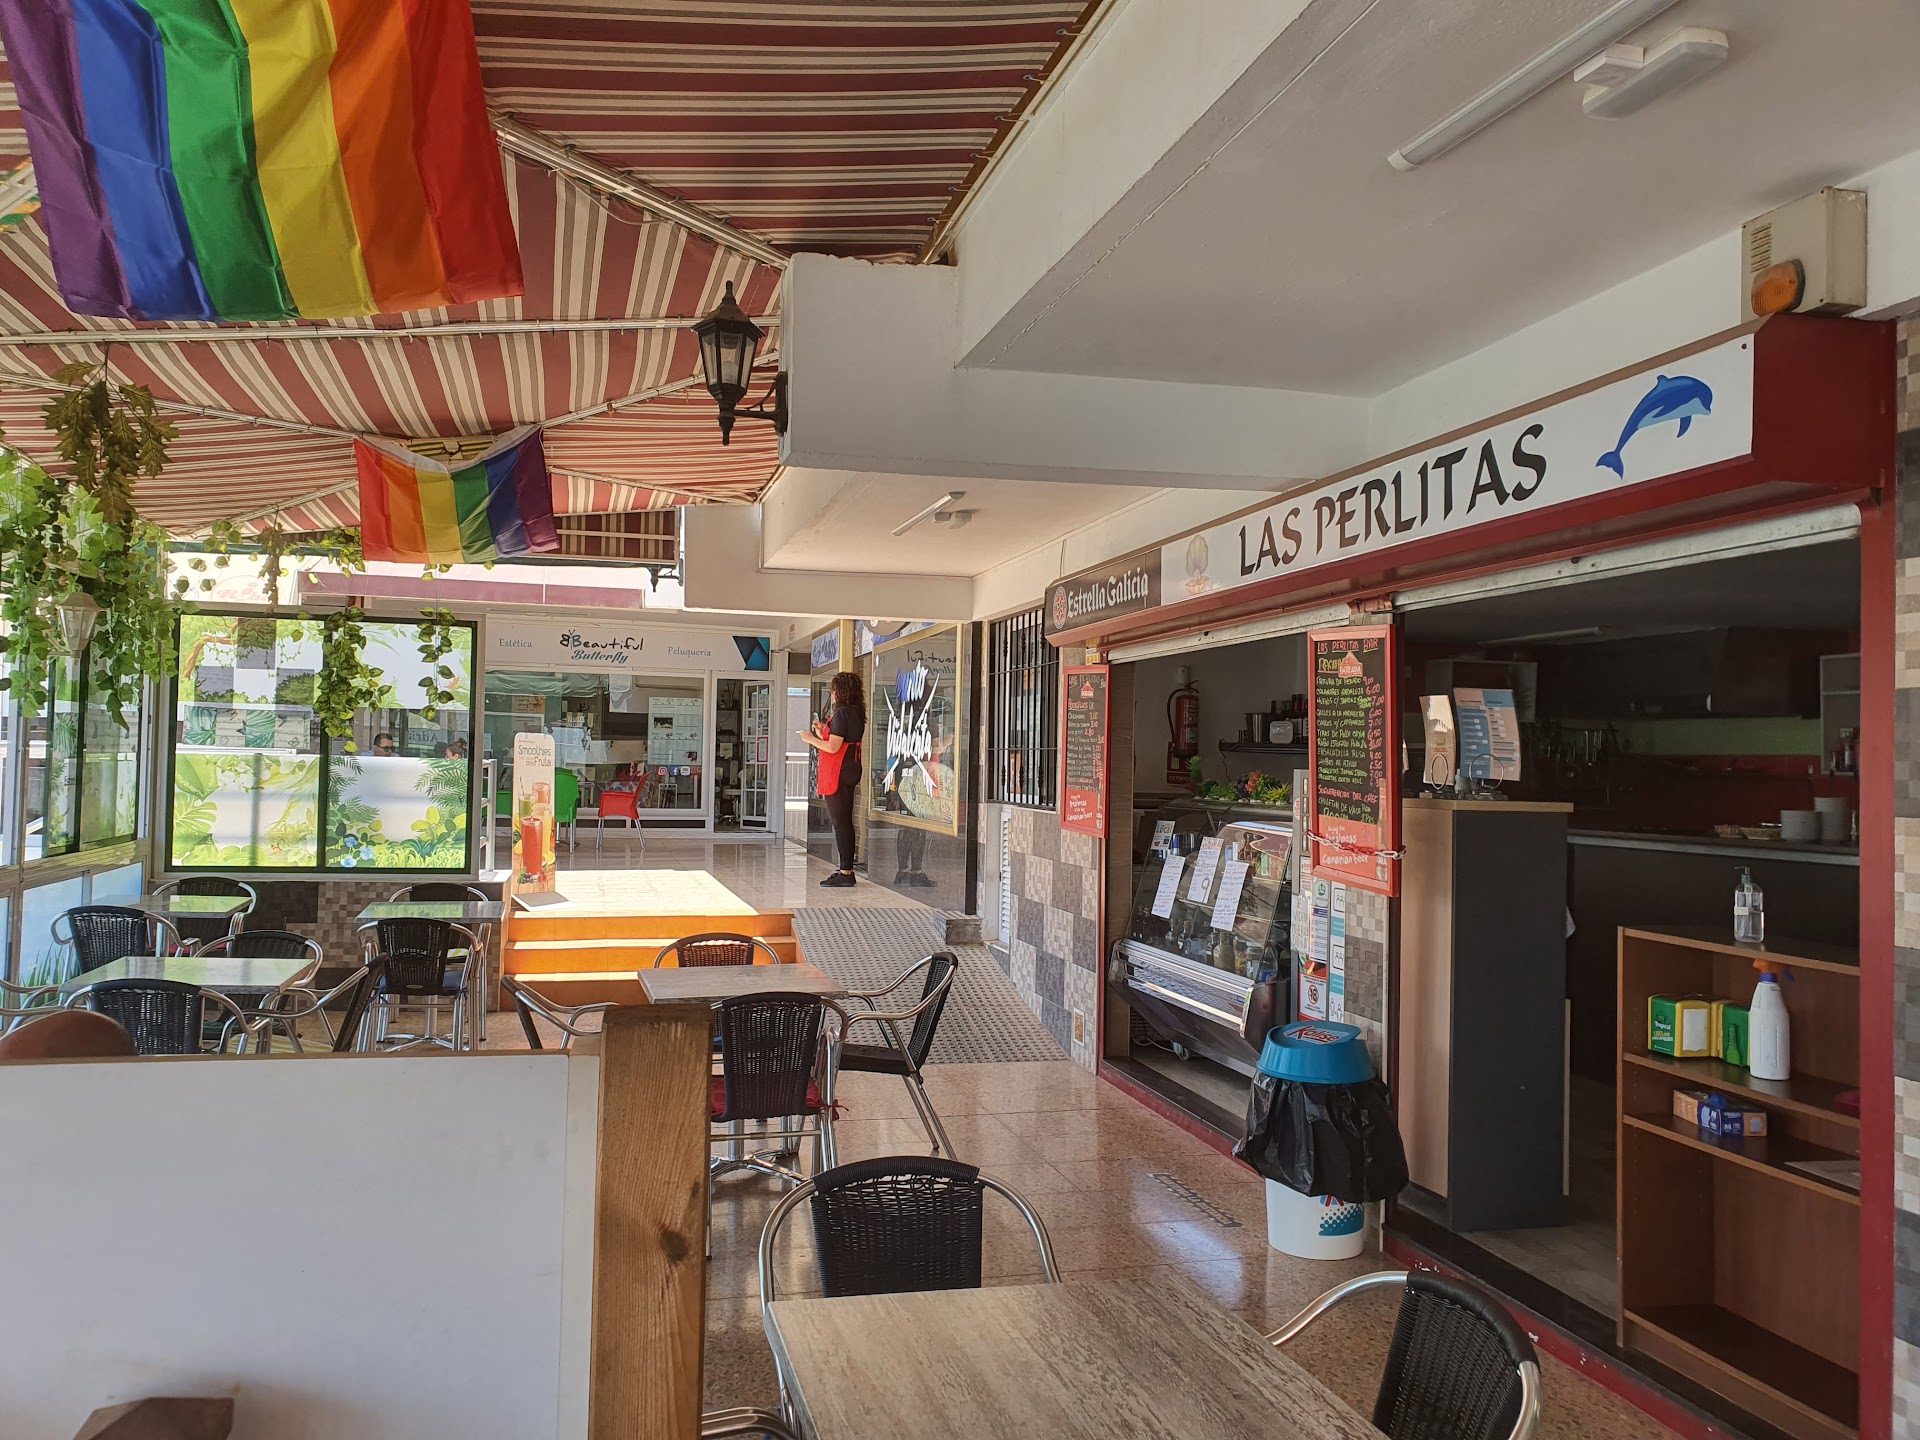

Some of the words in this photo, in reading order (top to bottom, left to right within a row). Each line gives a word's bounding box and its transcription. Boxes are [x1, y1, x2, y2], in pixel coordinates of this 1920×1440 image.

[1238, 507, 1303, 577] LAS
[1312, 423, 1548, 555] PERLITAS
[1067, 583, 1106, 619] Estrella
[1106, 567, 1149, 608] Galicia
[499, 638, 533, 648] Estética
[1317, 642, 1329, 654] LAS
[1332, 640, 1360, 651] PERLITAS
[1363, 638, 1379, 651] BAR
[571, 649, 629, 664] Butterfly
[667, 646, 712, 657] Peluquería
[1335, 678, 1342, 686] DE
[518, 744, 552, 757] Smoothies
[1317, 748, 1349, 757] ENSALADILLA
[1351, 749, 1366, 758] RUSA
[534, 756, 552, 767] Fruta
[1352, 791, 1362, 801] DEL
[1363, 793, 1379, 804] CHEF
[1340, 802, 1348, 812] DE
[1322, 854, 1352, 865] Canarian
[1352, 852, 1369, 864] beer
[1286, 1024, 1341, 1043] Kalise
